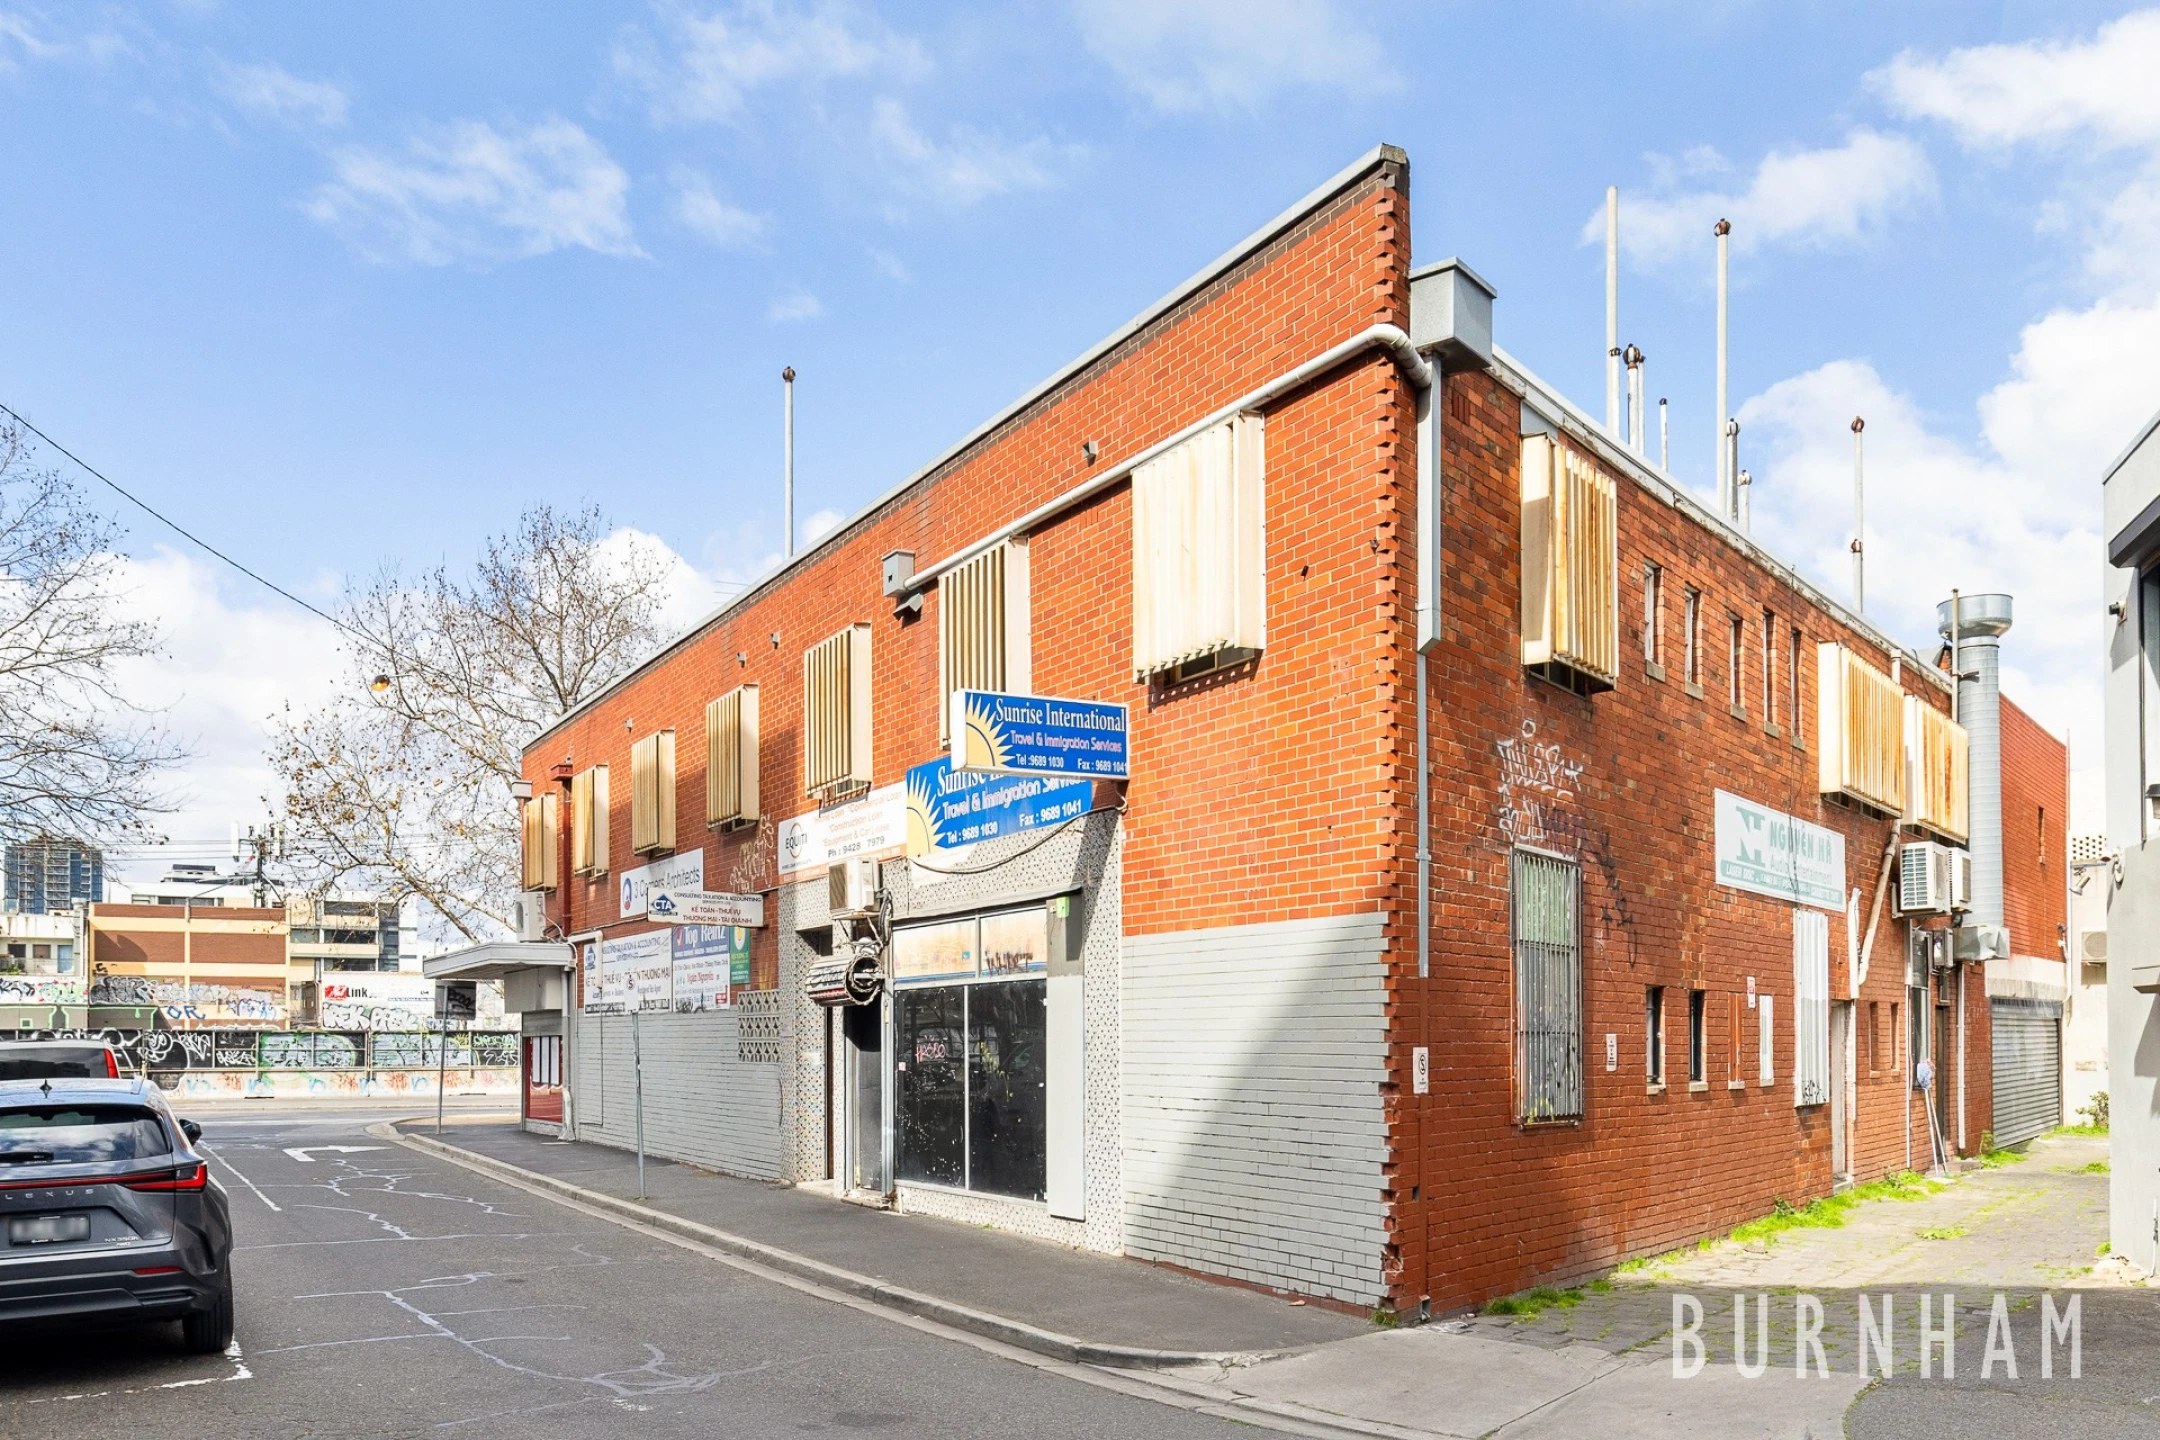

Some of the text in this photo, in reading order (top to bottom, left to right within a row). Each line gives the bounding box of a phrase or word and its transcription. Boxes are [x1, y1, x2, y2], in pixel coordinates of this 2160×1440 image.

[996, 698, 1126, 732] Sunrise International
[1010, 730, 1122, 754] Travel & Immigration Services
[1016, 754, 1027, 766] Tel
[1048, 756, 1065, 769] 1030
[1077, 758, 1090, 770] Fax
[1095, 760, 1111, 773] 9689
[942, 777, 1087, 820] Travel & Immigration Servic
[947, 831, 958, 846] Tel
[962, 826, 980, 841] 9689
[980, 821, 998, 838] 1030
[1019, 813, 1035, 828] Fax
[1040, 806, 1060, 822] 9689
[1061, 799, 1082, 817] 1041
[785, 833, 808, 850] EQUITI
[842, 842, 862, 855] 9428
[866, 836, 886, 848] 7979
[665, 865, 701, 890] Architects
[653, 899, 673, 911] CTA
[674, 892, 702, 900] CONSULTING
[684, 926, 698, 949] Top
[346, 987, 368, 998] Link
[5, 1189, 94, 1200] LEXUS
